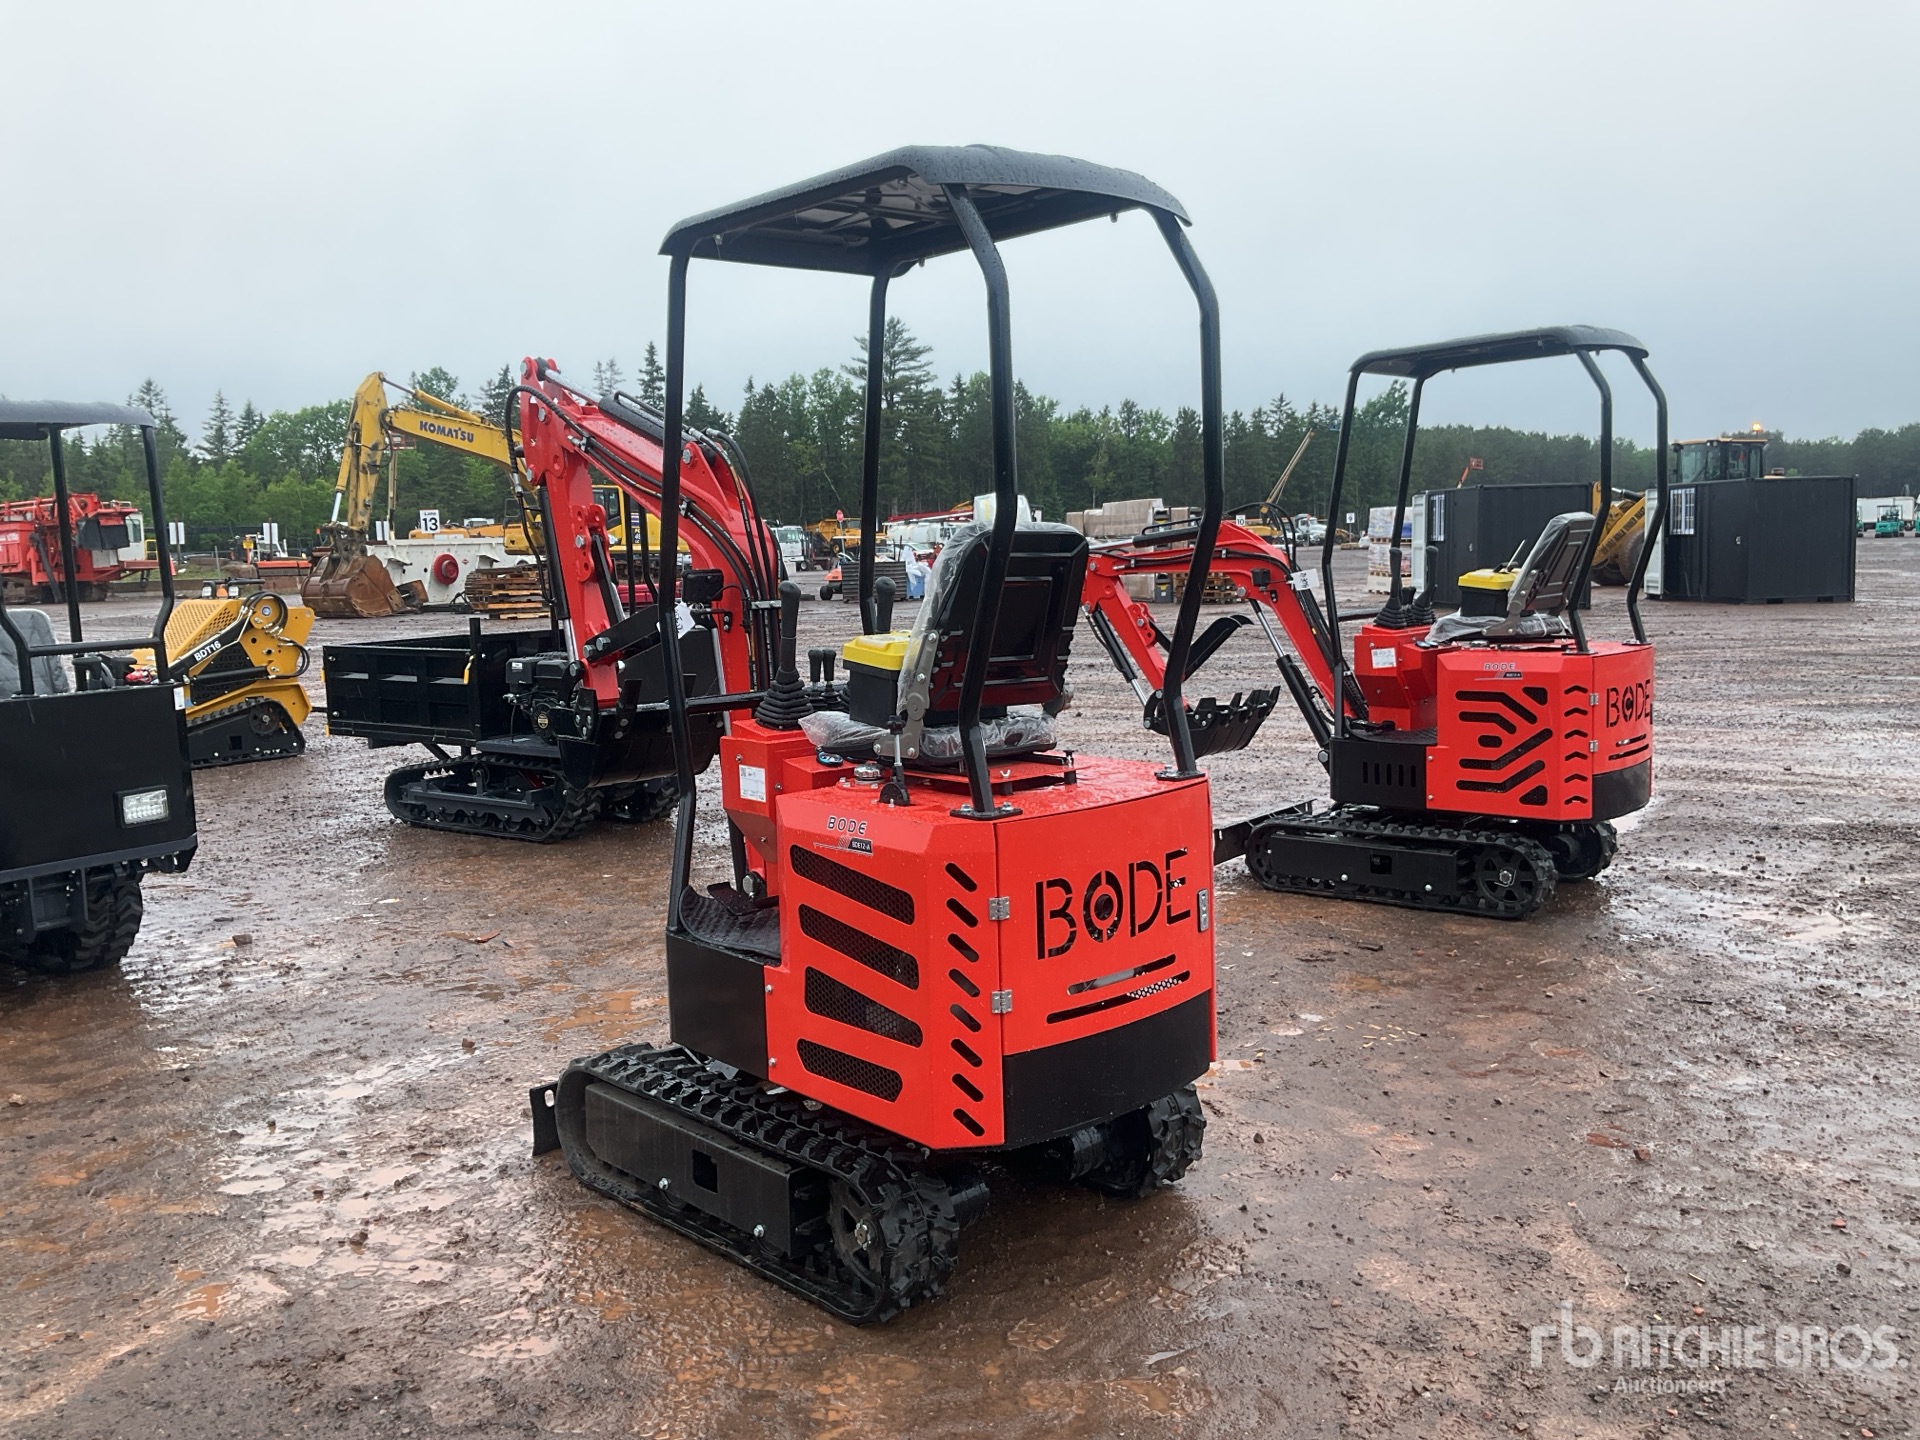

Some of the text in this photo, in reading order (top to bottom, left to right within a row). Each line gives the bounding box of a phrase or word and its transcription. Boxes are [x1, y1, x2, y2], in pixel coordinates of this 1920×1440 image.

[419, 420, 475, 443] KOMATSU
[422, 517, 438, 531] 13
[193, 640, 222, 662] BDT16
[1484, 663, 1515, 671] BODE
[1605, 678, 1651, 728] BODE
[827, 815, 867, 835] BODE
[1035, 846, 1191, 961] BODE
